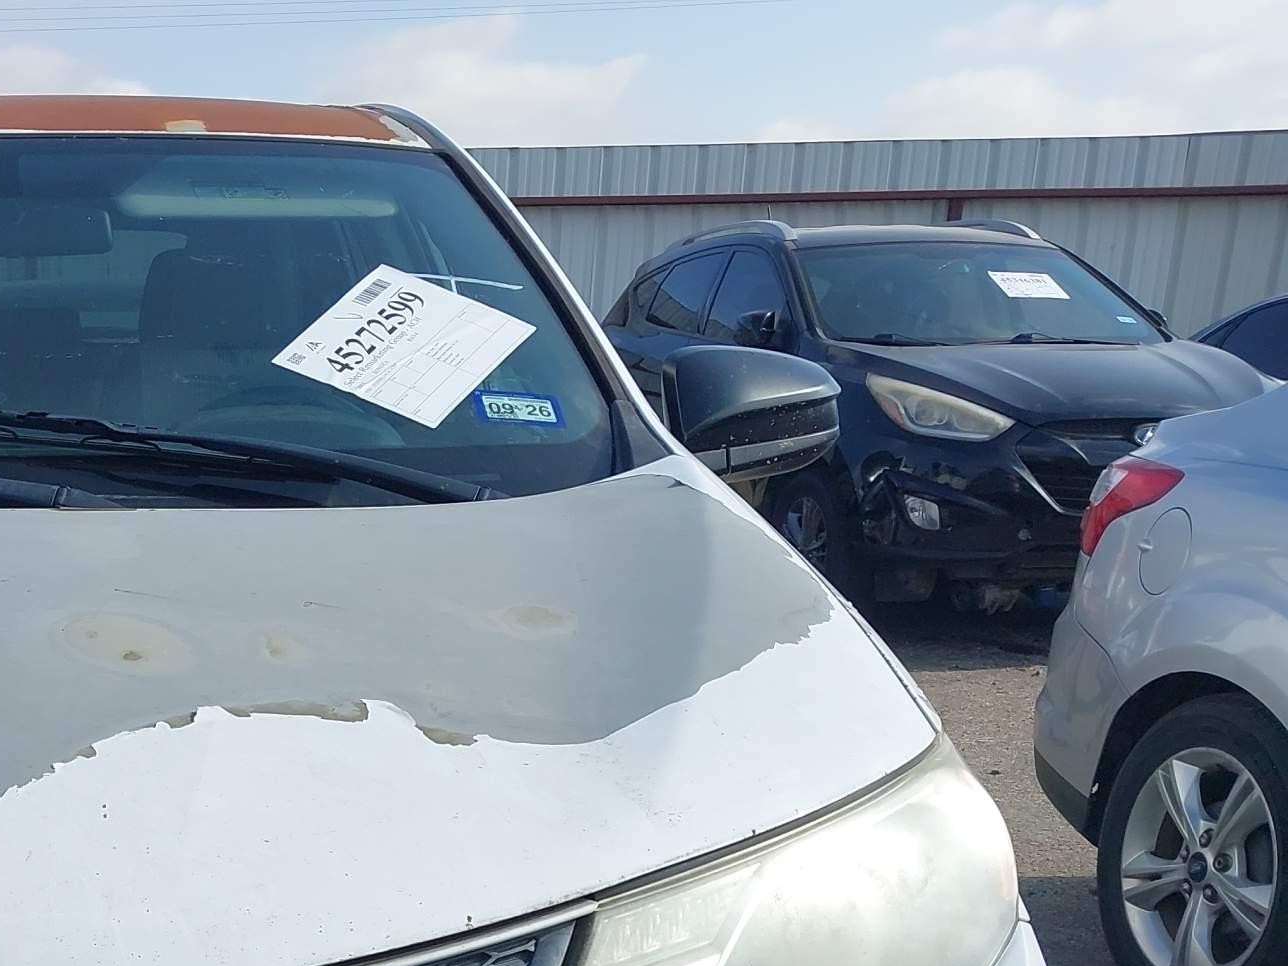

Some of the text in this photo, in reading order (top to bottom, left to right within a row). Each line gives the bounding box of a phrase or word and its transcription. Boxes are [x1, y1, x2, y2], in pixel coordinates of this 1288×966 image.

[325, 291, 425, 374] 45272599
[488, 401, 515, 415] 09
[525, 404, 552, 417] 26
